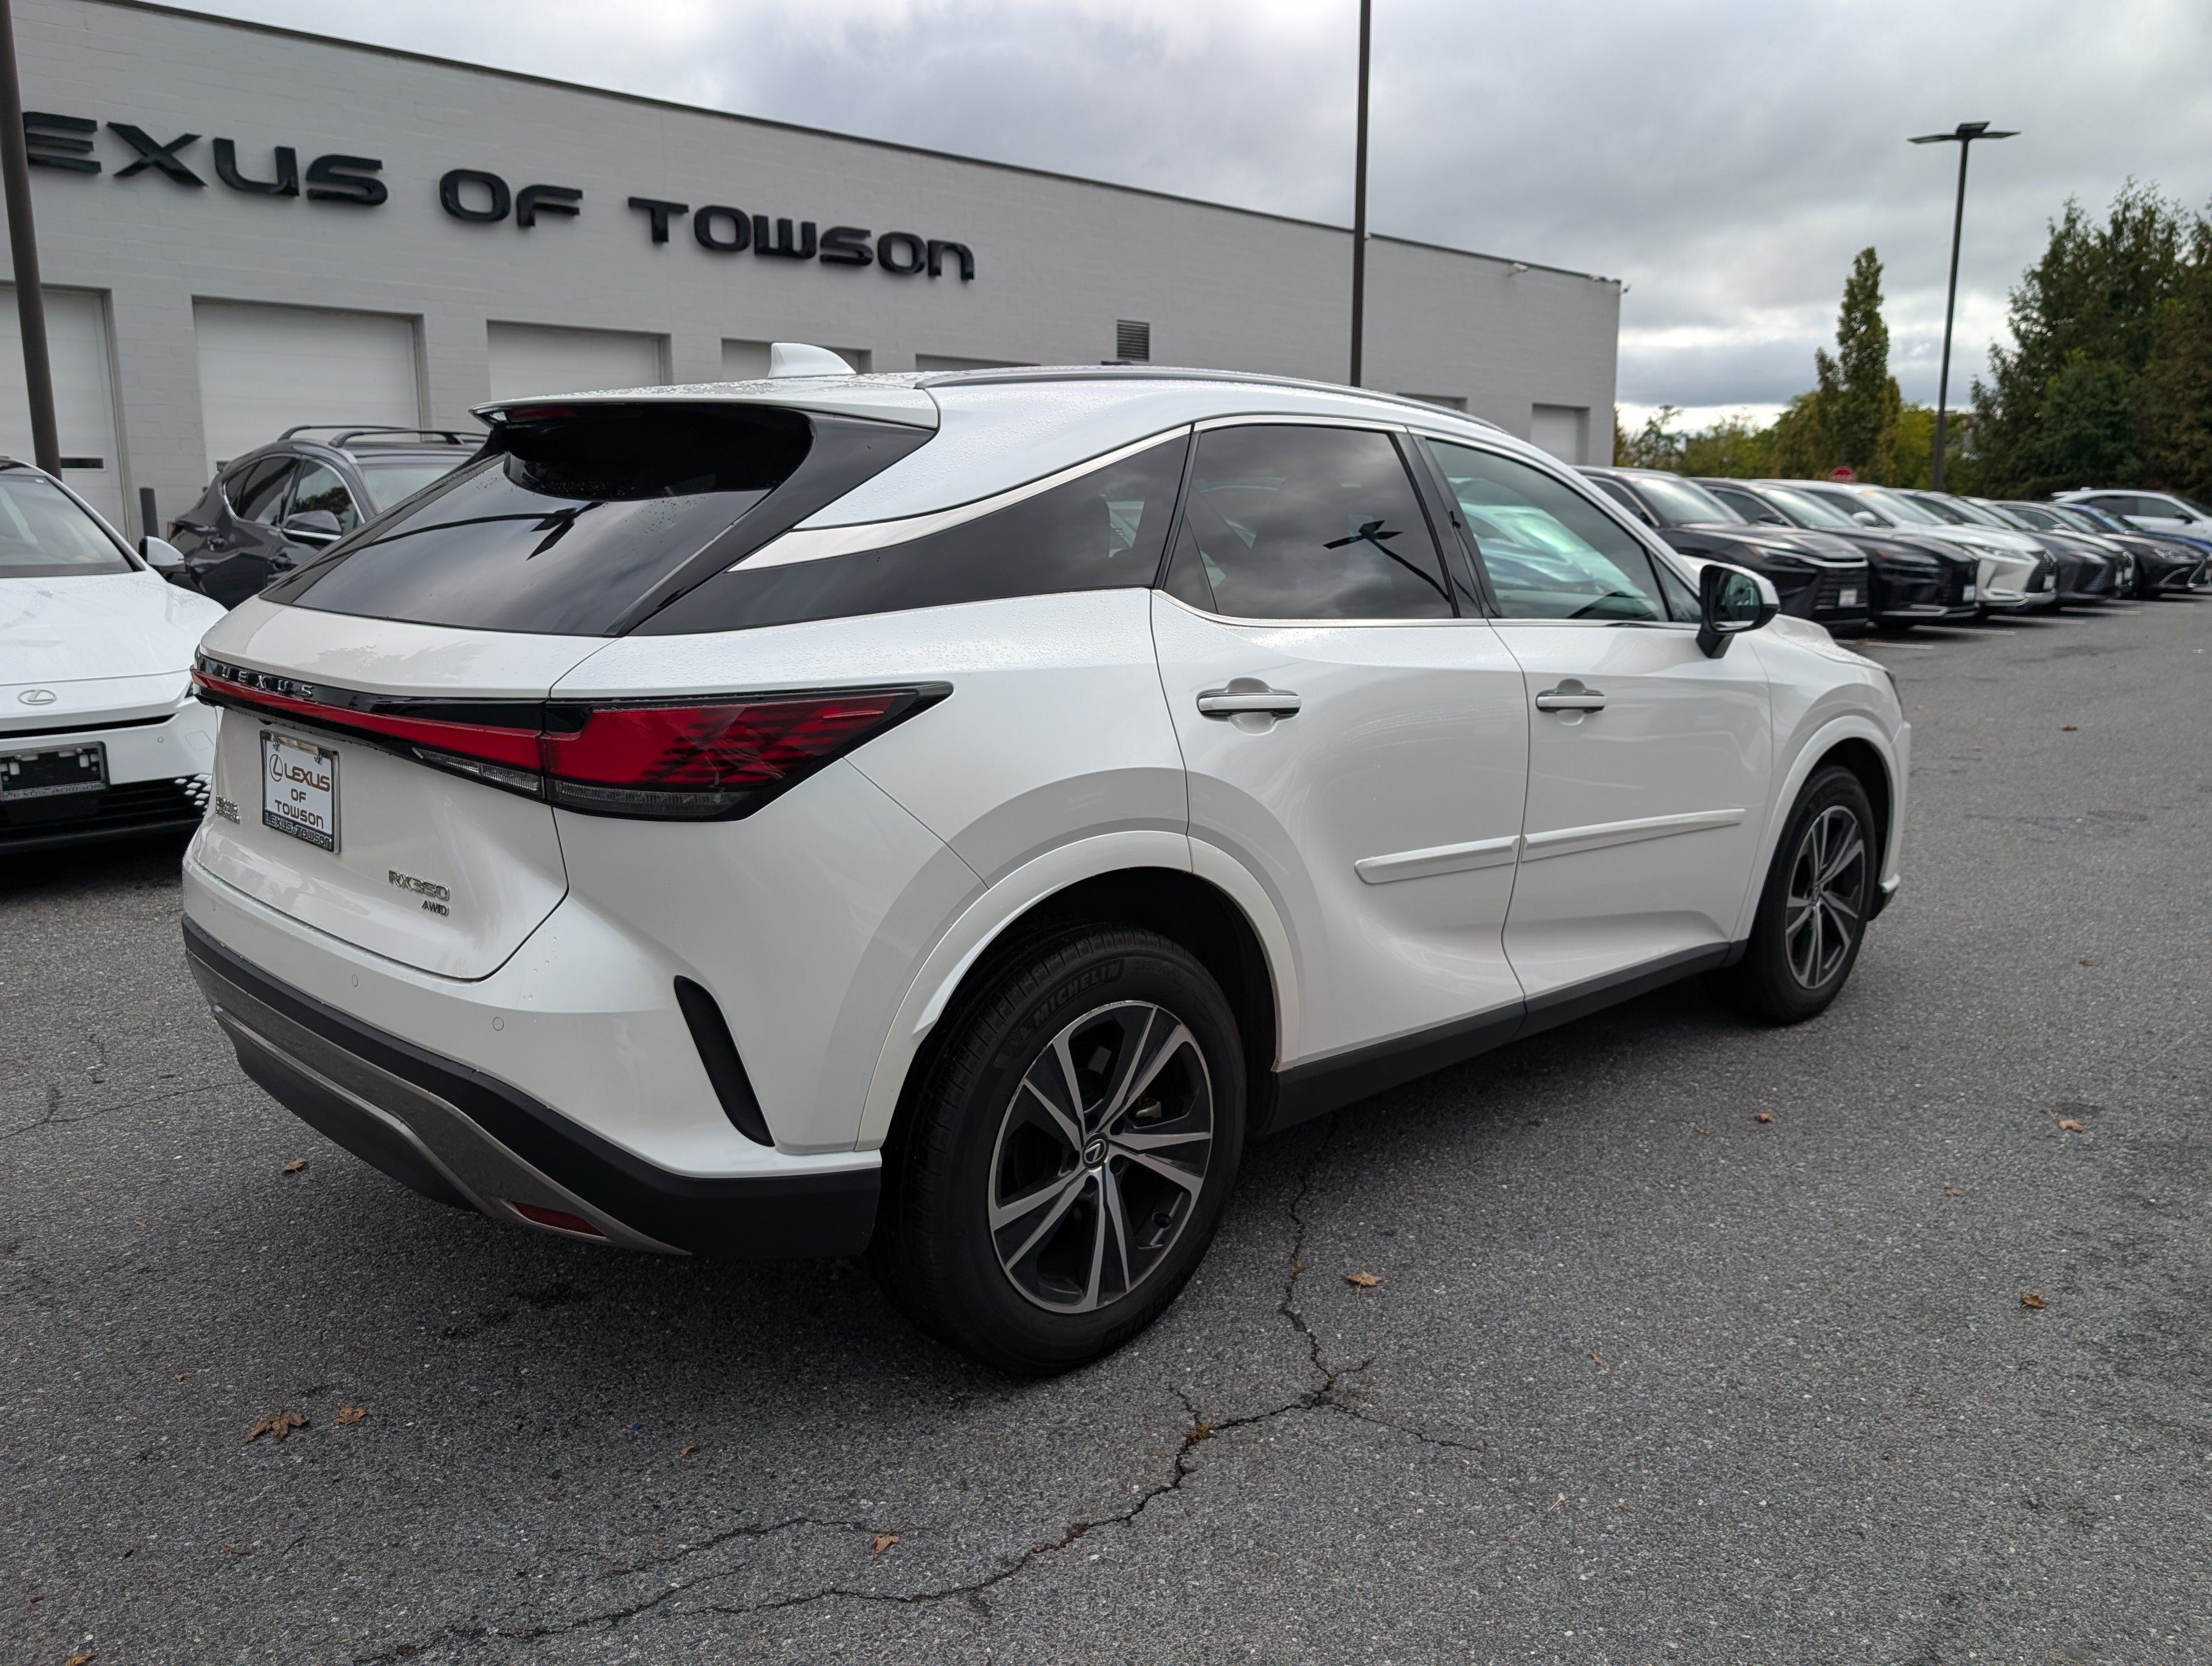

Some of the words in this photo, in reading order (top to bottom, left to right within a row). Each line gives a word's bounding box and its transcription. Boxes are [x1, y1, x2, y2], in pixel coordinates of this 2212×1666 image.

[22, 111, 389, 206] EXUS
[439, 168, 583, 227] OF
[628, 196, 975, 280] TOWSON
[284, 762, 330, 792] LEXUS
[291, 788, 306, 803] OF
[274, 799, 324, 829] TOWSON
[422, 899, 449, 916] AWD
[1033, 962, 1121, 1027] MICHELIN
